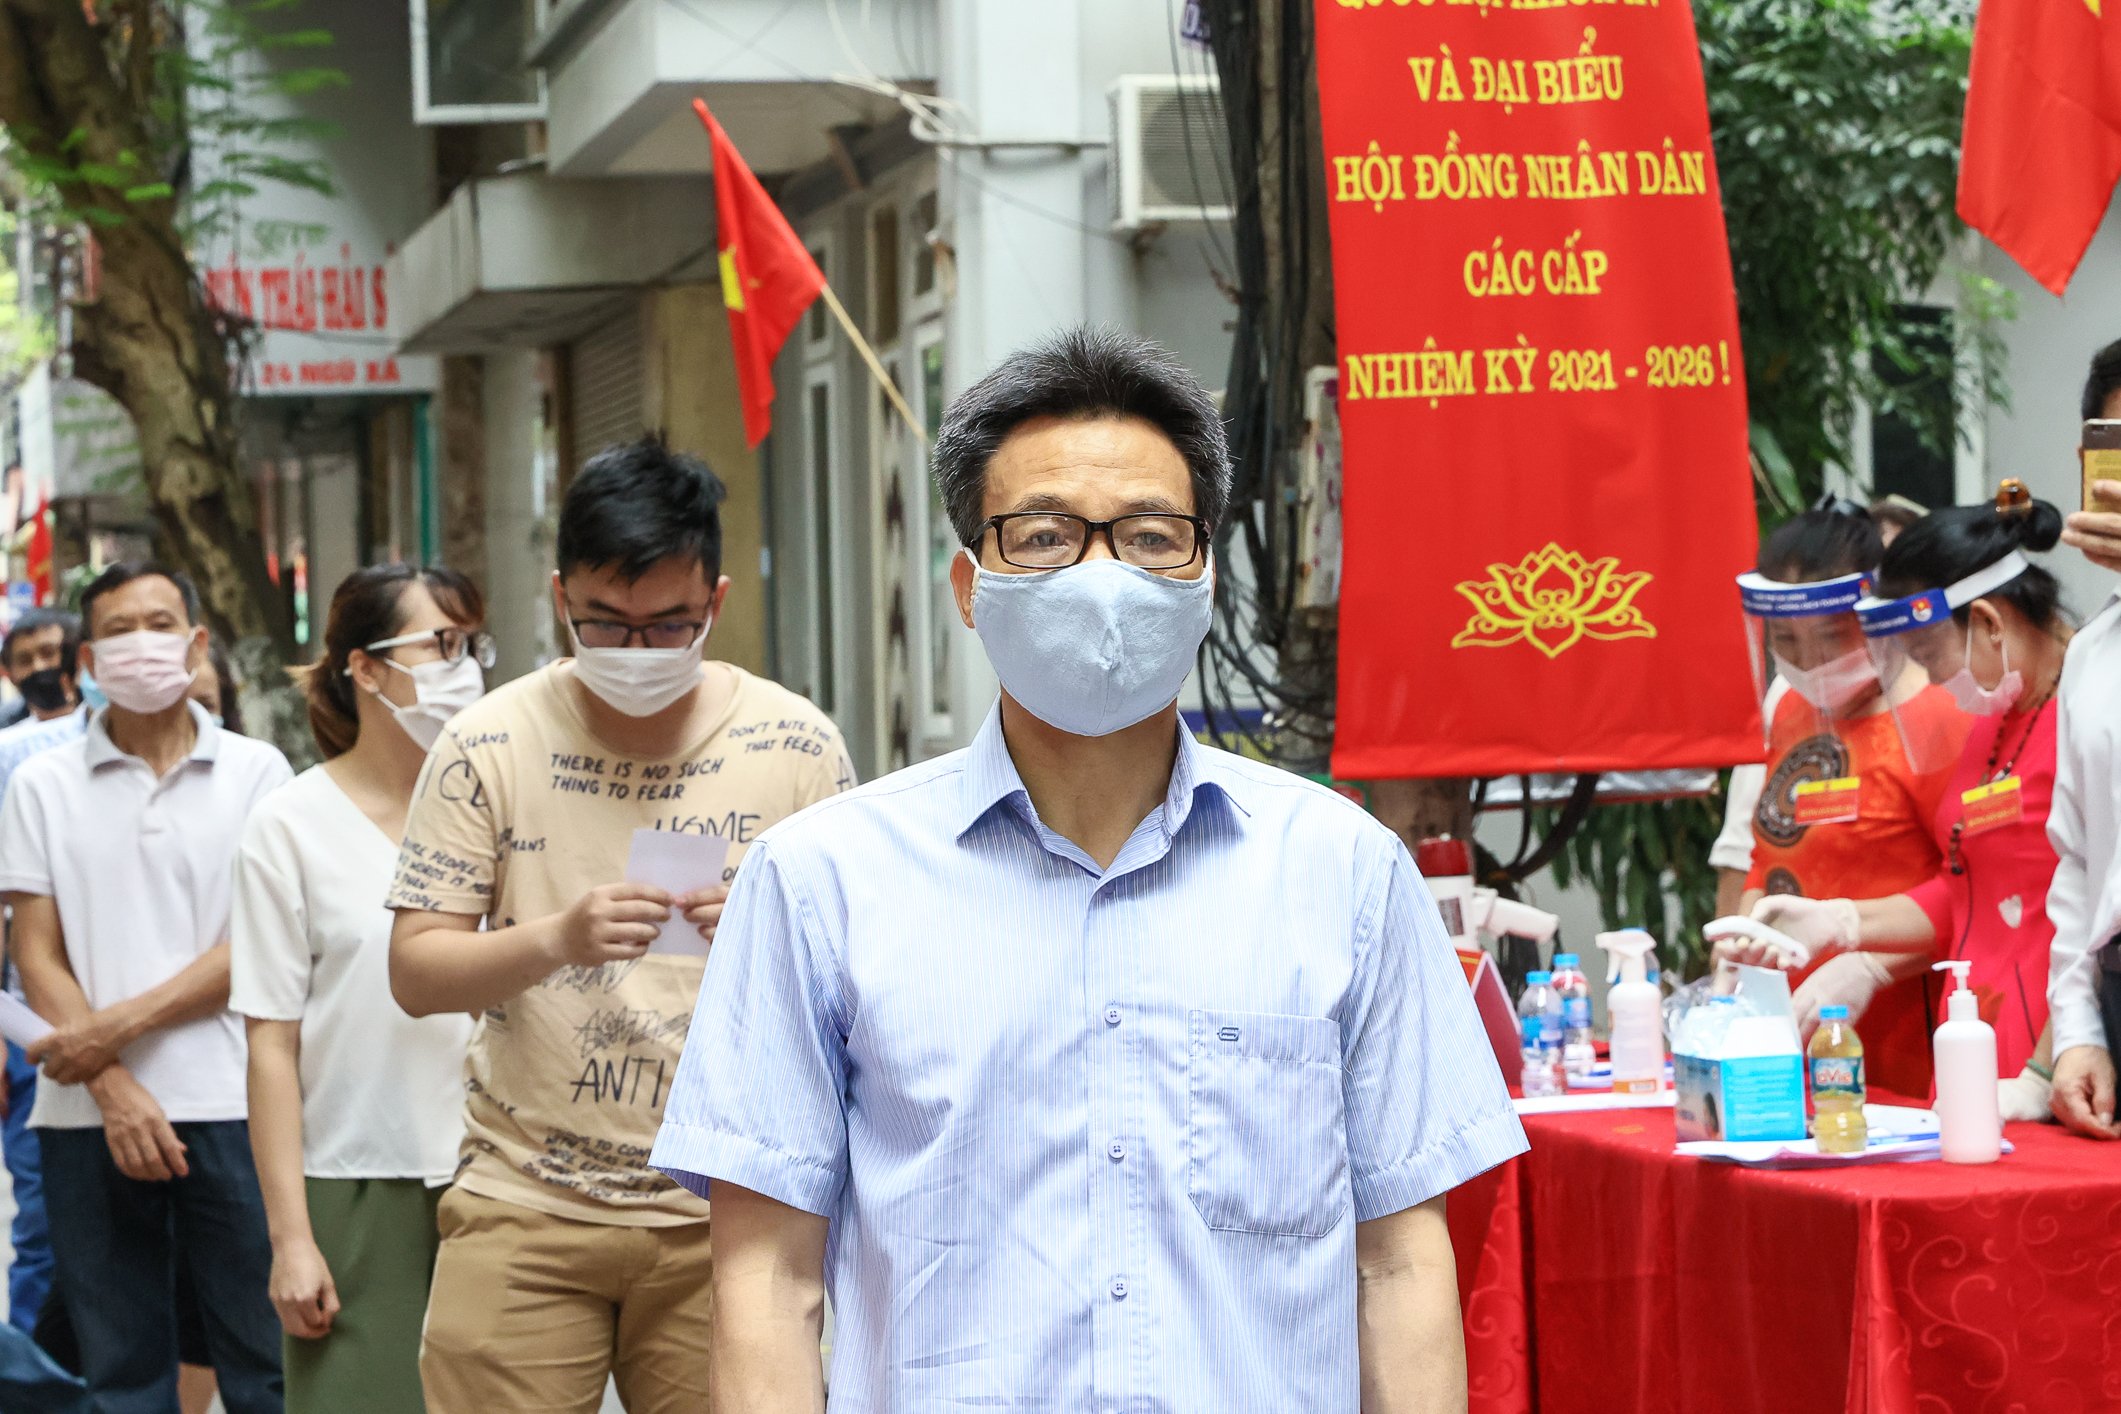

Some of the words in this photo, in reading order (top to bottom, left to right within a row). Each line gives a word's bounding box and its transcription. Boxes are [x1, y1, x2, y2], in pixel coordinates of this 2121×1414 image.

[1408, 43, 1463, 102] VÀ
[1470, 57, 1530, 114] ĐẠI
[1534, 26, 1623, 104] BIỂU
[1333, 140, 1405, 213] HỘI
[1413, 130, 1518, 200] ĐỒNG
[1523, 139, 1629, 199] NHÂN
[1635, 136, 1706, 195] DÂN
[1463, 235, 1536, 297] CÁC
[1541, 229, 1608, 296] CẤP
[1346, 336, 1475, 409] NHIỆM
[1484, 333, 1538, 394] KỲ
[1548, 350, 1618, 392] 2021
[551, 754, 604, 775] THERE
[614, 762, 632, 779] IS
[642, 764, 671, 780] NO
[677, 757, 725, 779] SUCH
[783, 736, 823, 757] FEED
[552, 775, 601, 795] THING
[608, 782, 630, 800] TO
[637, 784, 685, 801] FEAR
[570, 1055, 664, 1108] ANTI
